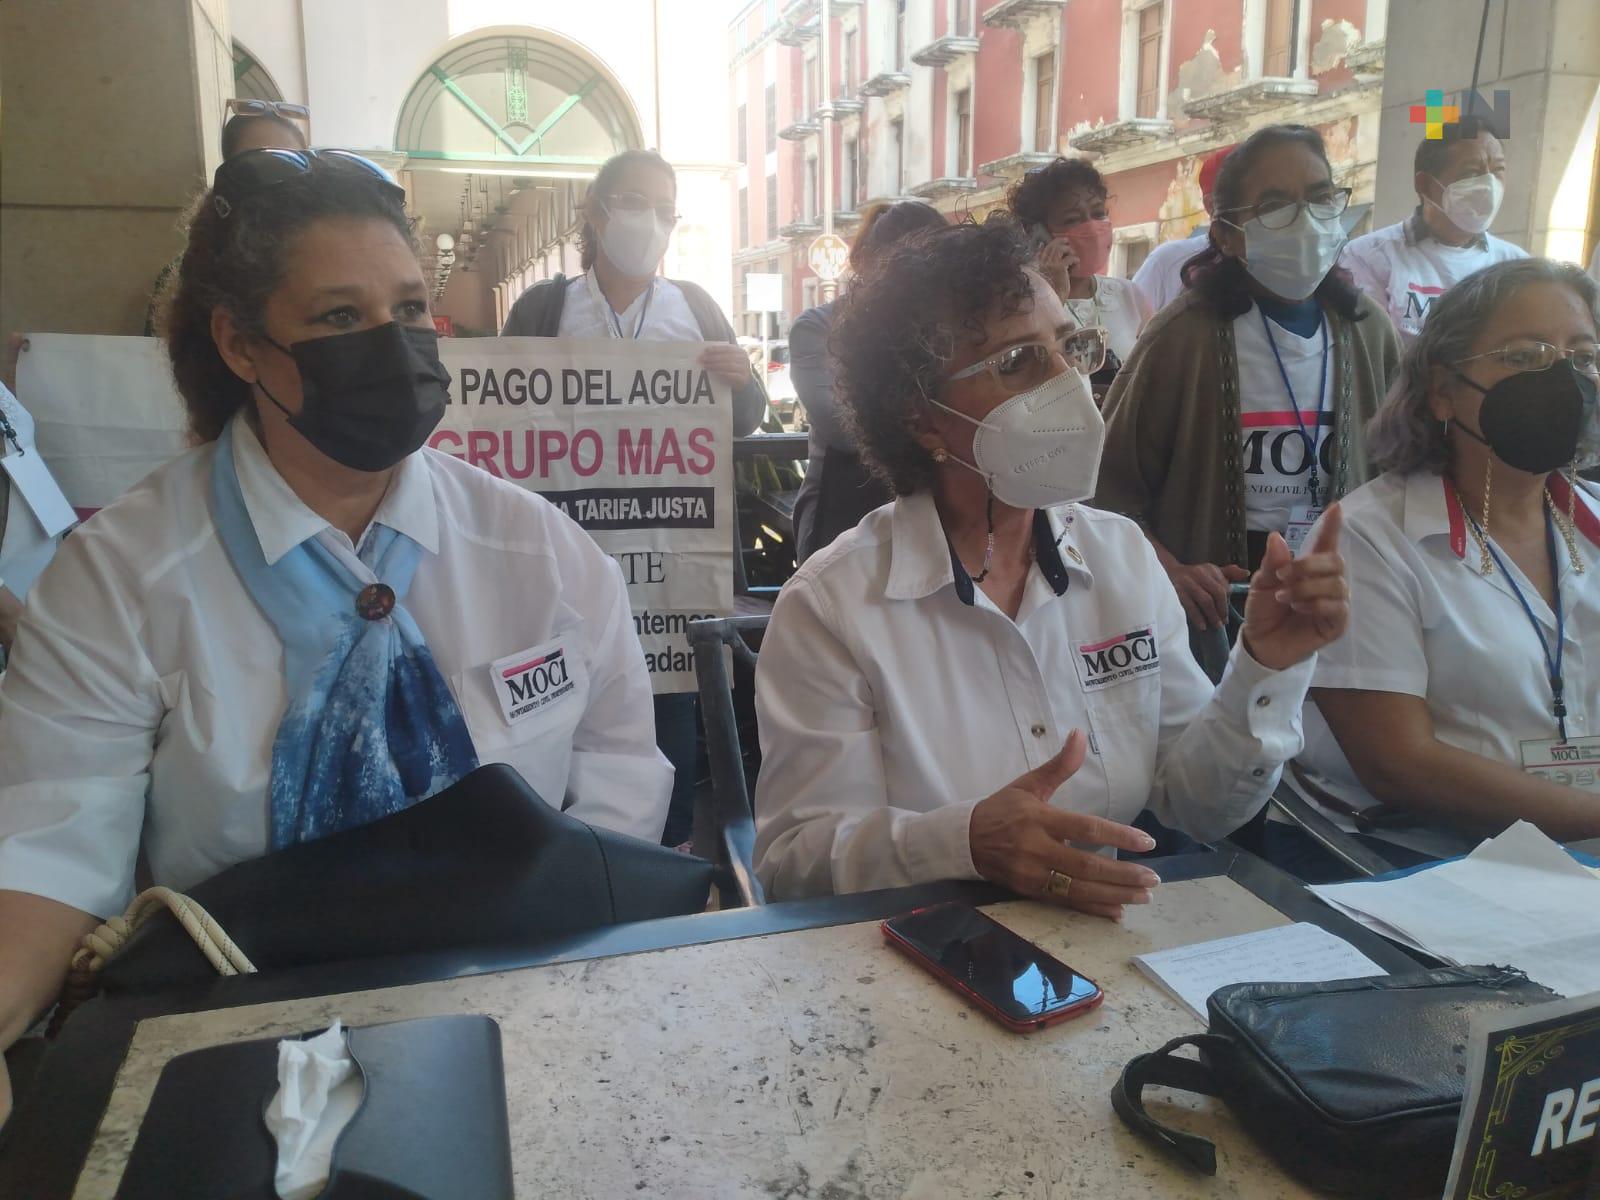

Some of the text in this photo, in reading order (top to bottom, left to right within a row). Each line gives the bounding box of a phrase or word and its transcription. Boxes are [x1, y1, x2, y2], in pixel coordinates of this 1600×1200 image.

[461, 369, 552, 405] PAGO
[562, 370, 622, 404] DEL
[628, 370, 715, 404] AGUA
[428, 428, 715, 479] GRUPO MAS
[576, 499, 642, 521] TARIFA
[646, 497, 708, 519] JUSTA
[610, 552, 665, 585] TE
[1082, 637, 1158, 676] MOCI
[505, 658, 569, 706] MOCI
[1551, 749, 1580, 761] MOCI
